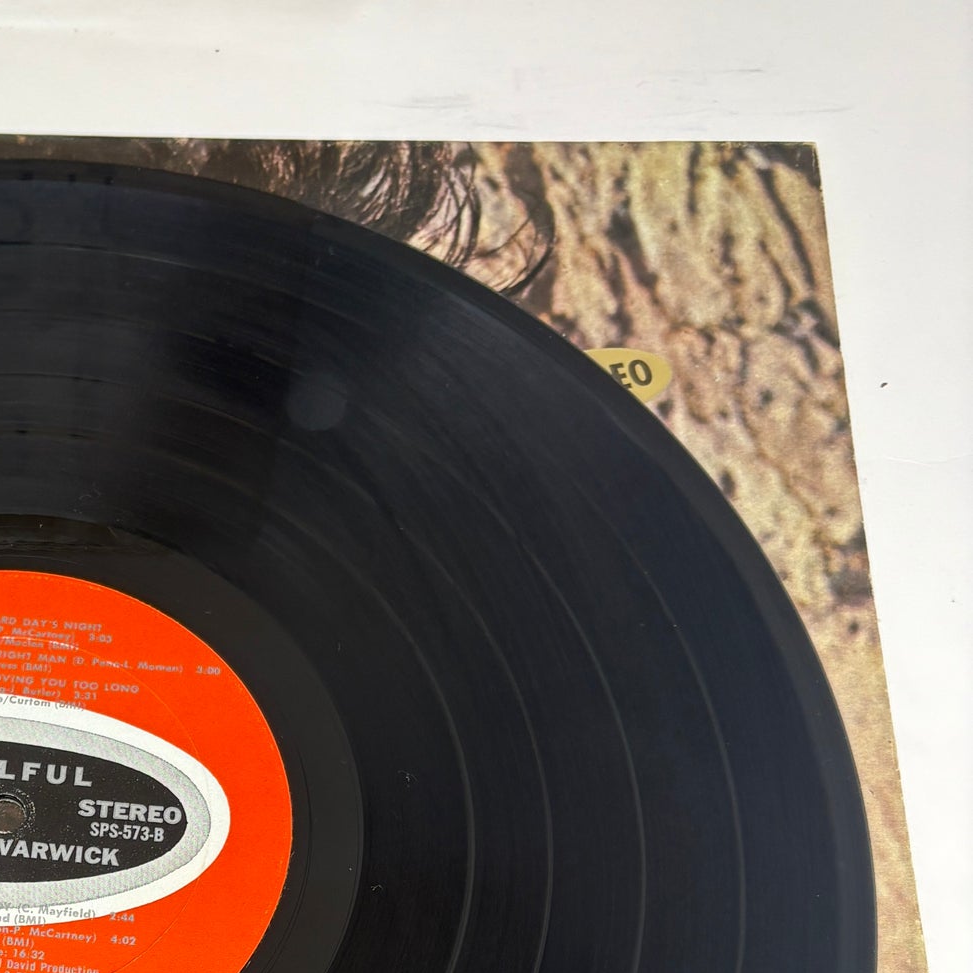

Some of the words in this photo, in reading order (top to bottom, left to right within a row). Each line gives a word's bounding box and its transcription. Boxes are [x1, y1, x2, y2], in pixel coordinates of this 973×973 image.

[22, 618, 58, 629] DAY'S
[63, 620, 102, 632] NIGHT
[88, 633, 113, 643] 3:03
[38, 653, 67, 664] MAN
[40, 676, 67, 688] YOU
[73, 680, 99, 691] TOO
[104, 683, 140, 694] LONG
[78, 798, 183, 826] STEREO
[89, 822, 165, 844] SPS-573-B
[17, 902, 34, 914] (C.
[38, 904, 96, 920] Mayfield)
[109, 911, 136, 923] 2:44
[14, 913, 47, 927] (BMI)
[1, 935, 35, 949] (BMI)
[29, 926, 97, 943] McCartney)
[110, 935, 137, 946] 4:02
[6, 959, 36, 972] David
